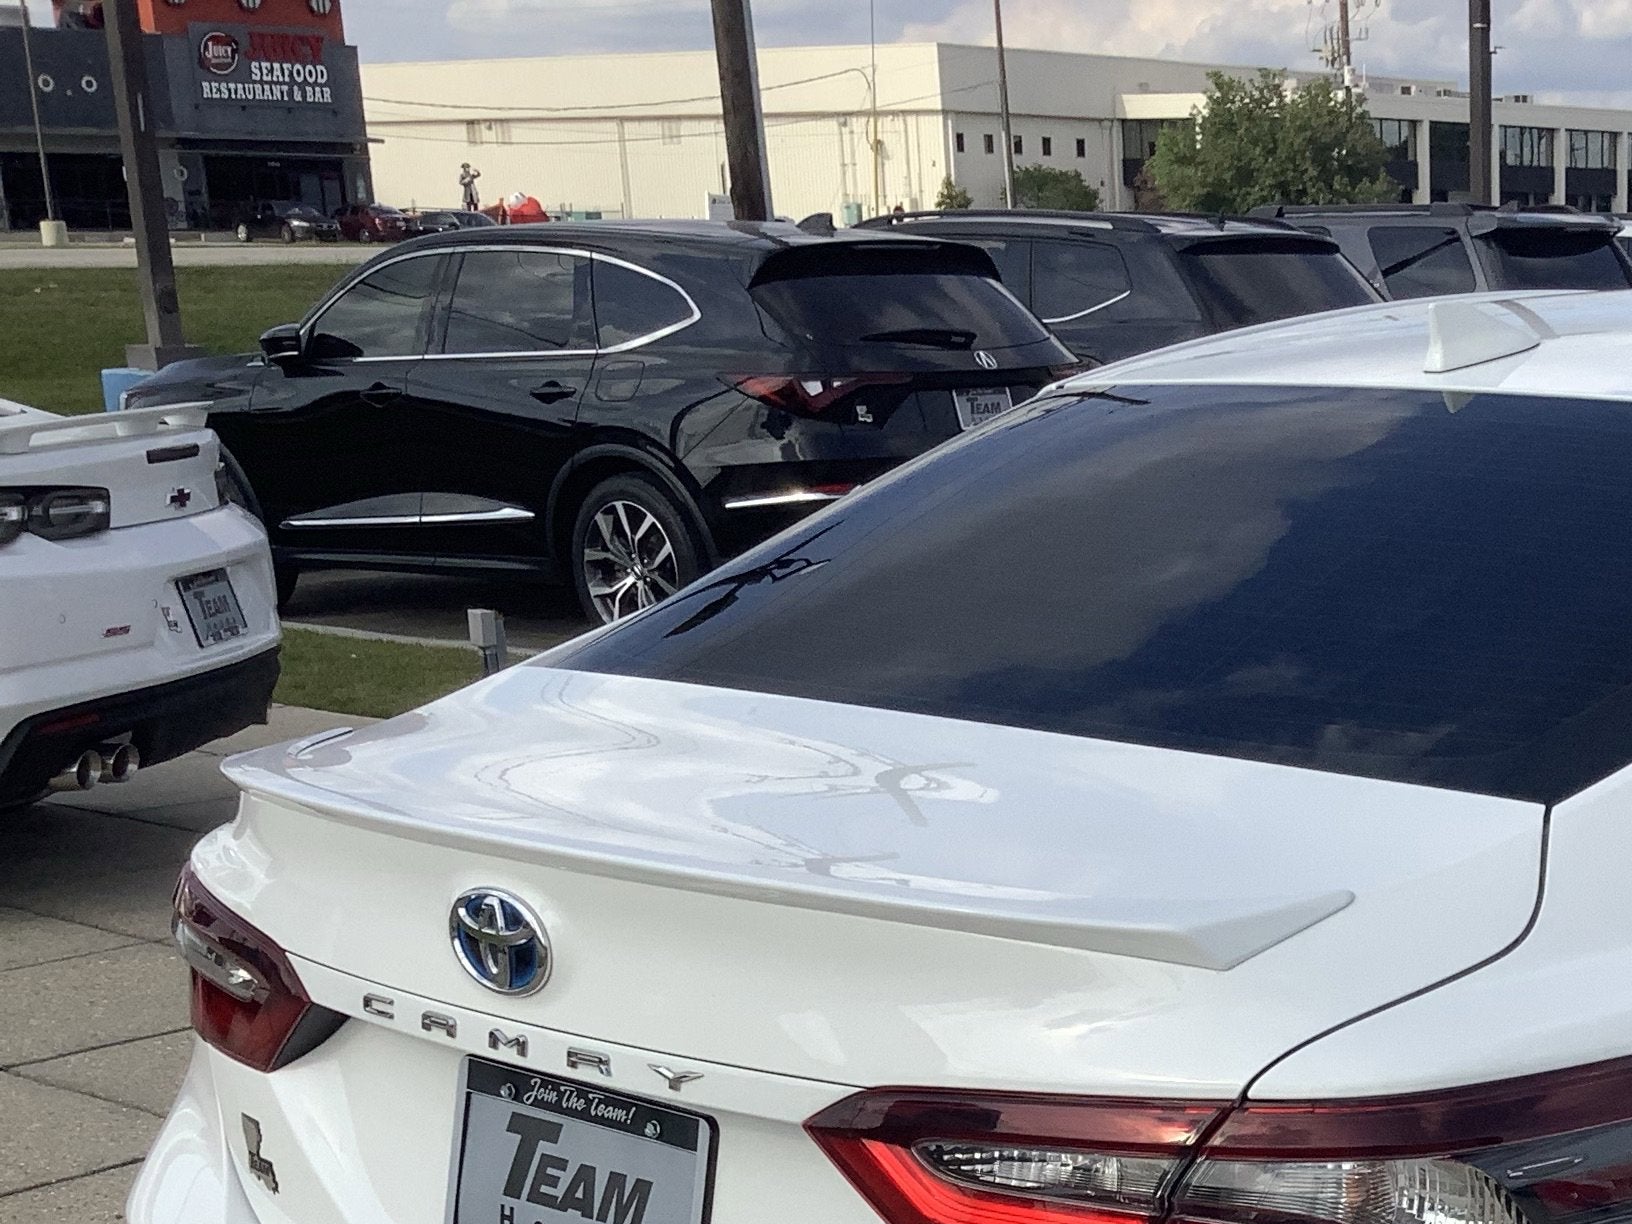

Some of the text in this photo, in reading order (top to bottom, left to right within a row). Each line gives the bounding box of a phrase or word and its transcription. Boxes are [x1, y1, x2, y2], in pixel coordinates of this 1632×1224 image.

[250, 61, 328, 83] SEAFOOD
[201, 81, 289, 101] RESTAURANT
[305, 86, 332, 103] BAR
[362, 992, 705, 1093] CAMRY
[522, 1078, 636, 1125] Join The Team!
